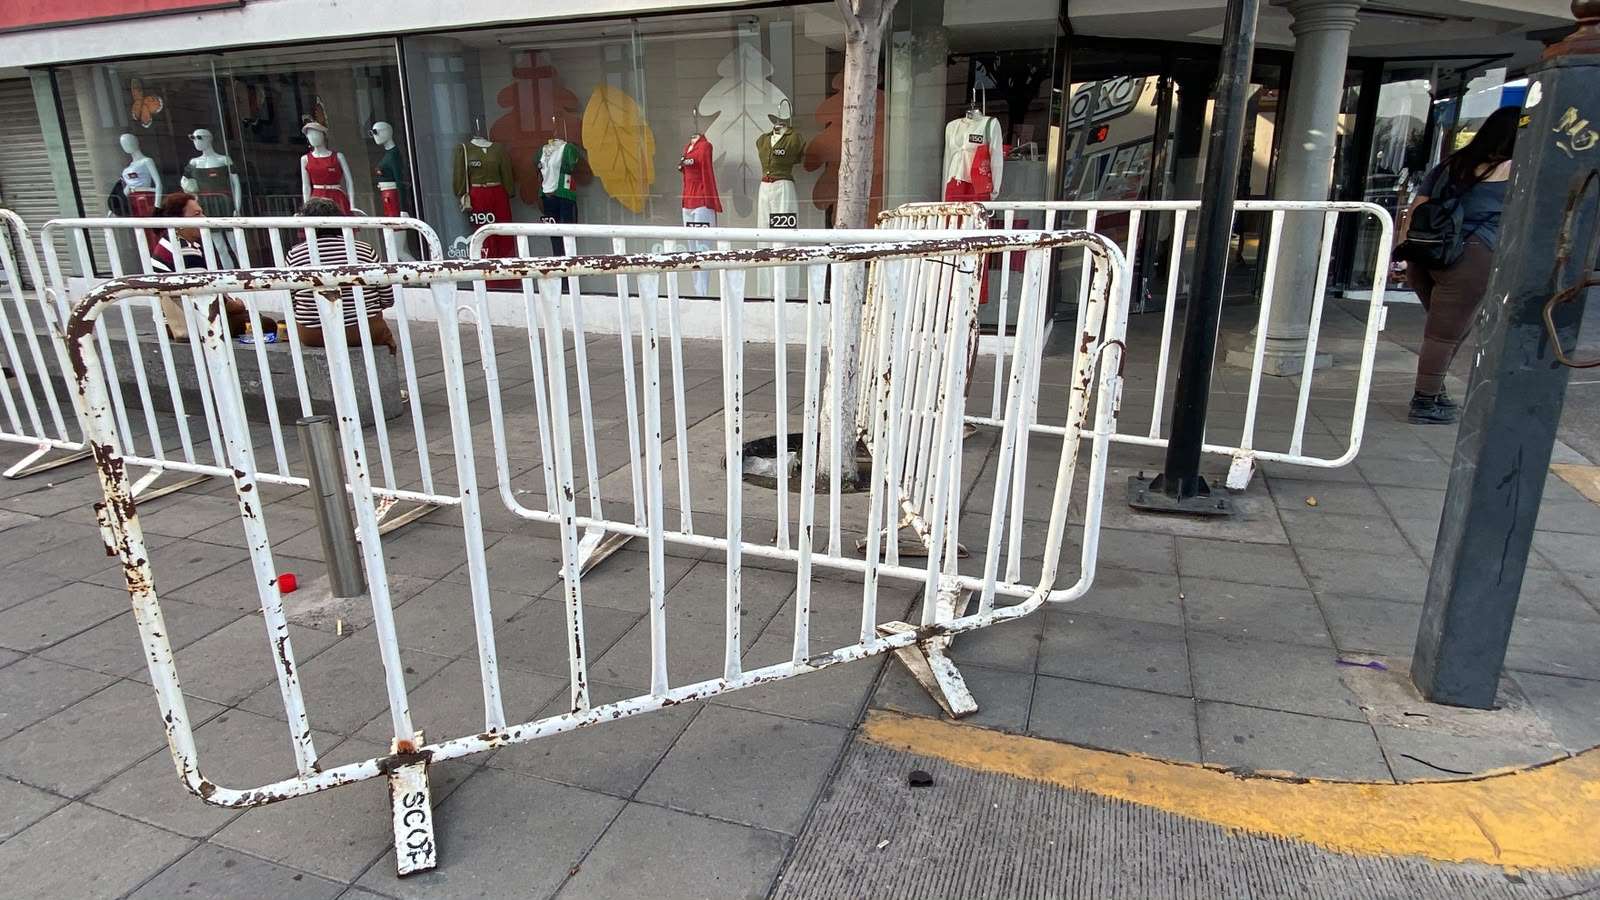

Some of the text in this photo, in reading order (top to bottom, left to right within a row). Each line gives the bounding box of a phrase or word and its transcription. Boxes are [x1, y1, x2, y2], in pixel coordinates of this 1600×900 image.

[1072, 79, 1133, 117] OXO
[470, 212, 496, 225] $190
[770, 215, 796, 227] $220
